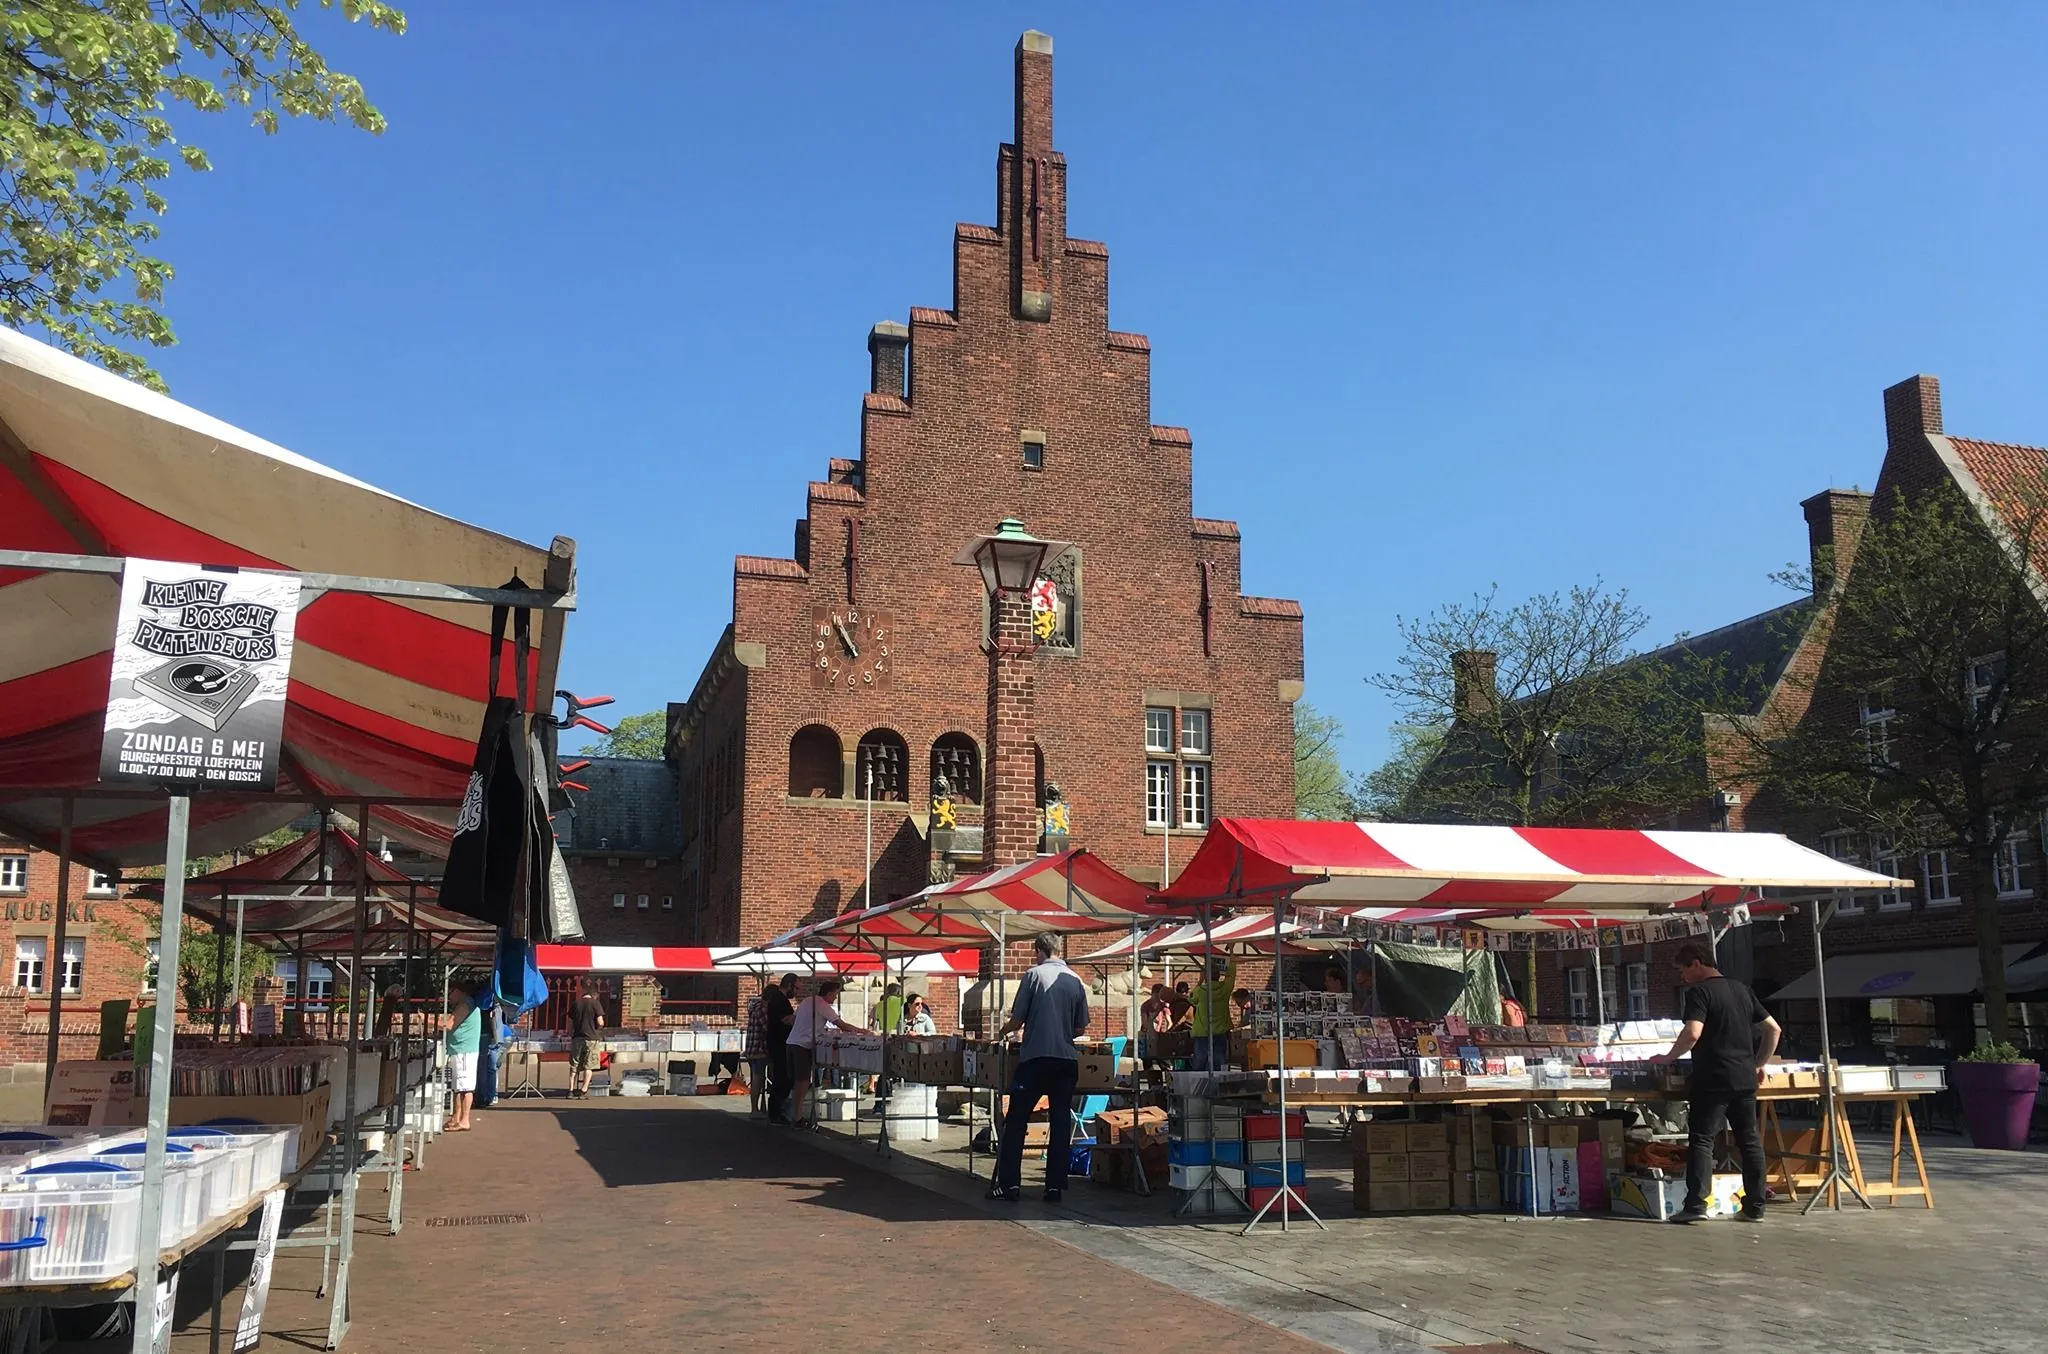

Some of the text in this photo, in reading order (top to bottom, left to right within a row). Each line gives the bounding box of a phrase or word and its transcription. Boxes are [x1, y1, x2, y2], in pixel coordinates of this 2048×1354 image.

[149, 581, 222, 605] KLEINE
[183, 605, 273, 633] BOSSCHE
[848, 612, 858, 622] 12
[820, 625, 830, 636] 10
[877, 630, 884, 640] 2
[135, 622, 274, 659] PLATENBEURS
[817, 641, 824, 651] 9
[881, 646, 887, 656] 3
[821, 657, 828, 667] 8
[876, 661, 883, 671] 4
[832, 670, 839, 679] 7
[847, 674, 856, 685] 6
[864, 672, 871, 682] 5
[122, 732, 265, 758] ZONDAG 6 MEI
[120, 750, 263, 770] BURGEMEESTER LOEFFPLEIN
[119, 762, 173, 776] 11.00-17.00
[176, 767, 197, 778] UUR
[206, 769, 226, 780] DEN
[228, 770, 261, 782] BOSCH
[5, 902, 97, 921] NUBKK
